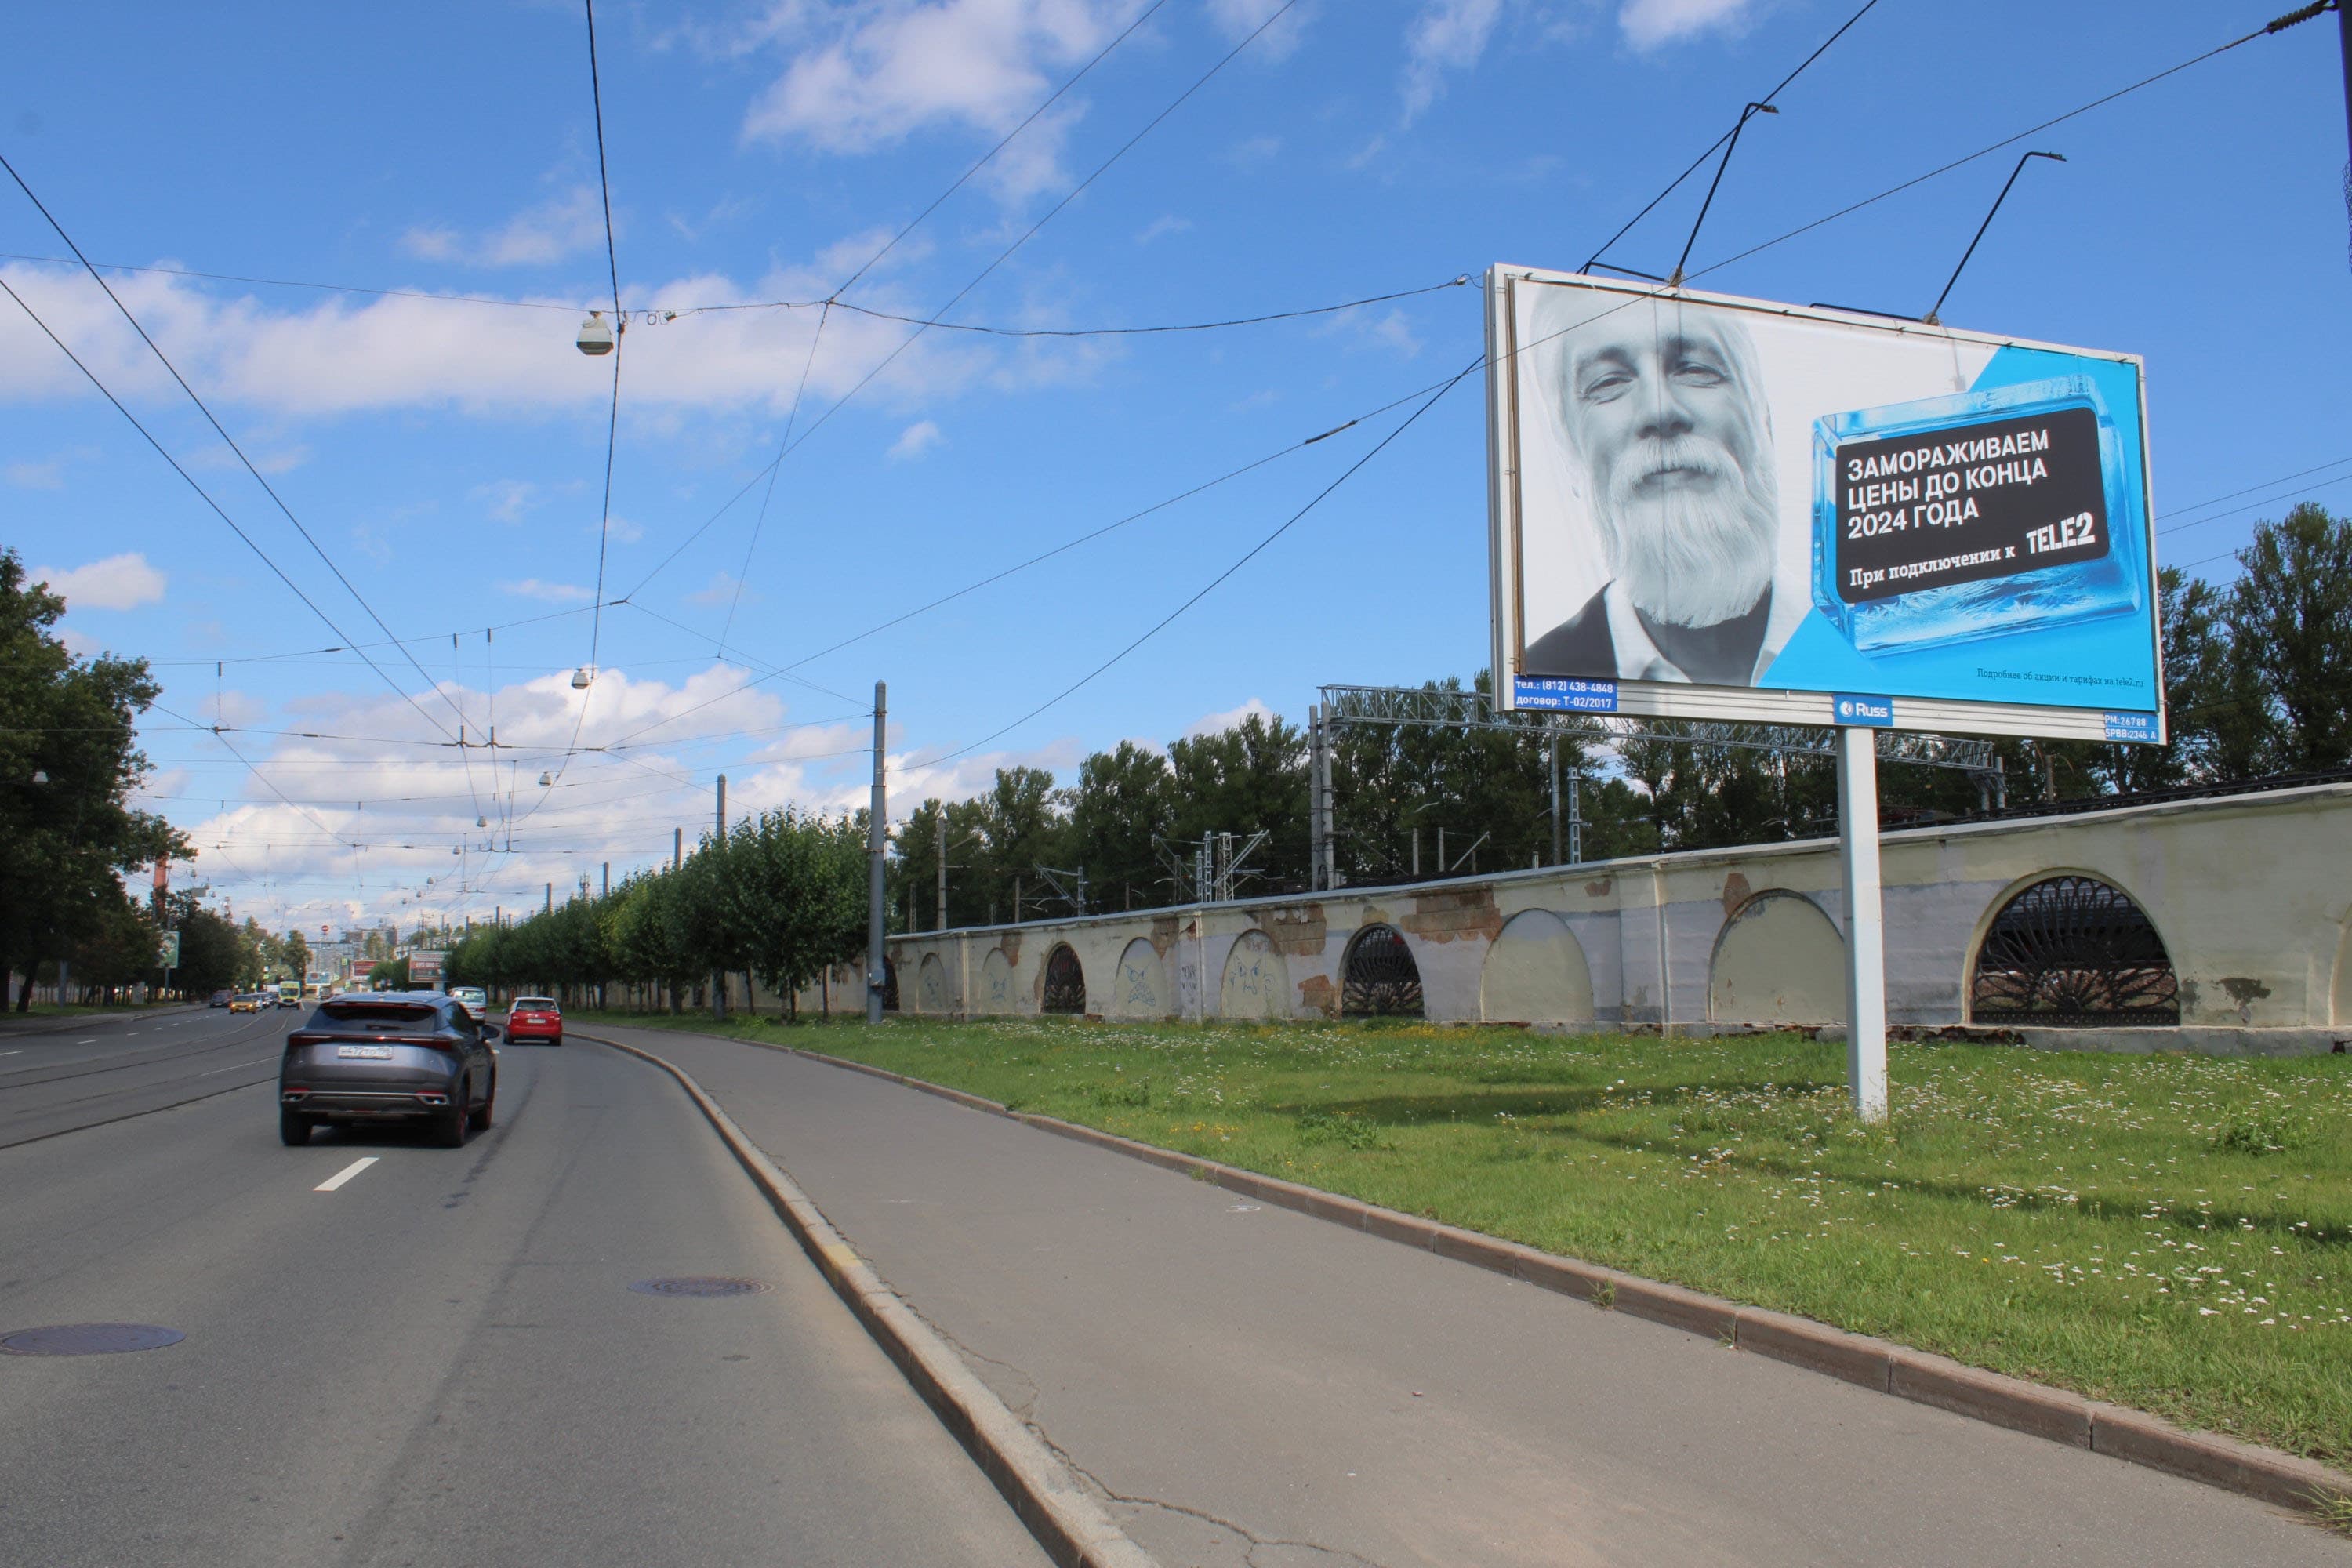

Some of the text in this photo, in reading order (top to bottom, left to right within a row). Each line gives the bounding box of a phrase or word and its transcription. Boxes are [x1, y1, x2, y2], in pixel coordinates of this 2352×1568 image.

[1847, 429, 2049, 481] ЗАМОРАЖИВАЕМ
[1849, 458, 2048, 513] ЦЕНЫ ДО КОНЦА
[1848, 497, 1979, 539] 2024 ГОДА
[2026, 511, 2096, 554] TELE2
[1849, 546, 2016, 589] При подключении к
[1515, 680, 1613, 694] тел.: (812) 438-4848
[1976, 668, 2021, 681] Подробнее
[2023, 671, 2033, 681] об
[2034, 673, 2060, 682] акции
[2069, 675, 2102, 686] тарифах
[2115, 677, 2143, 688] tele2.ru
[1515, 695, 1561, 708] договор:
[1855, 702, 1889, 717] Russ
